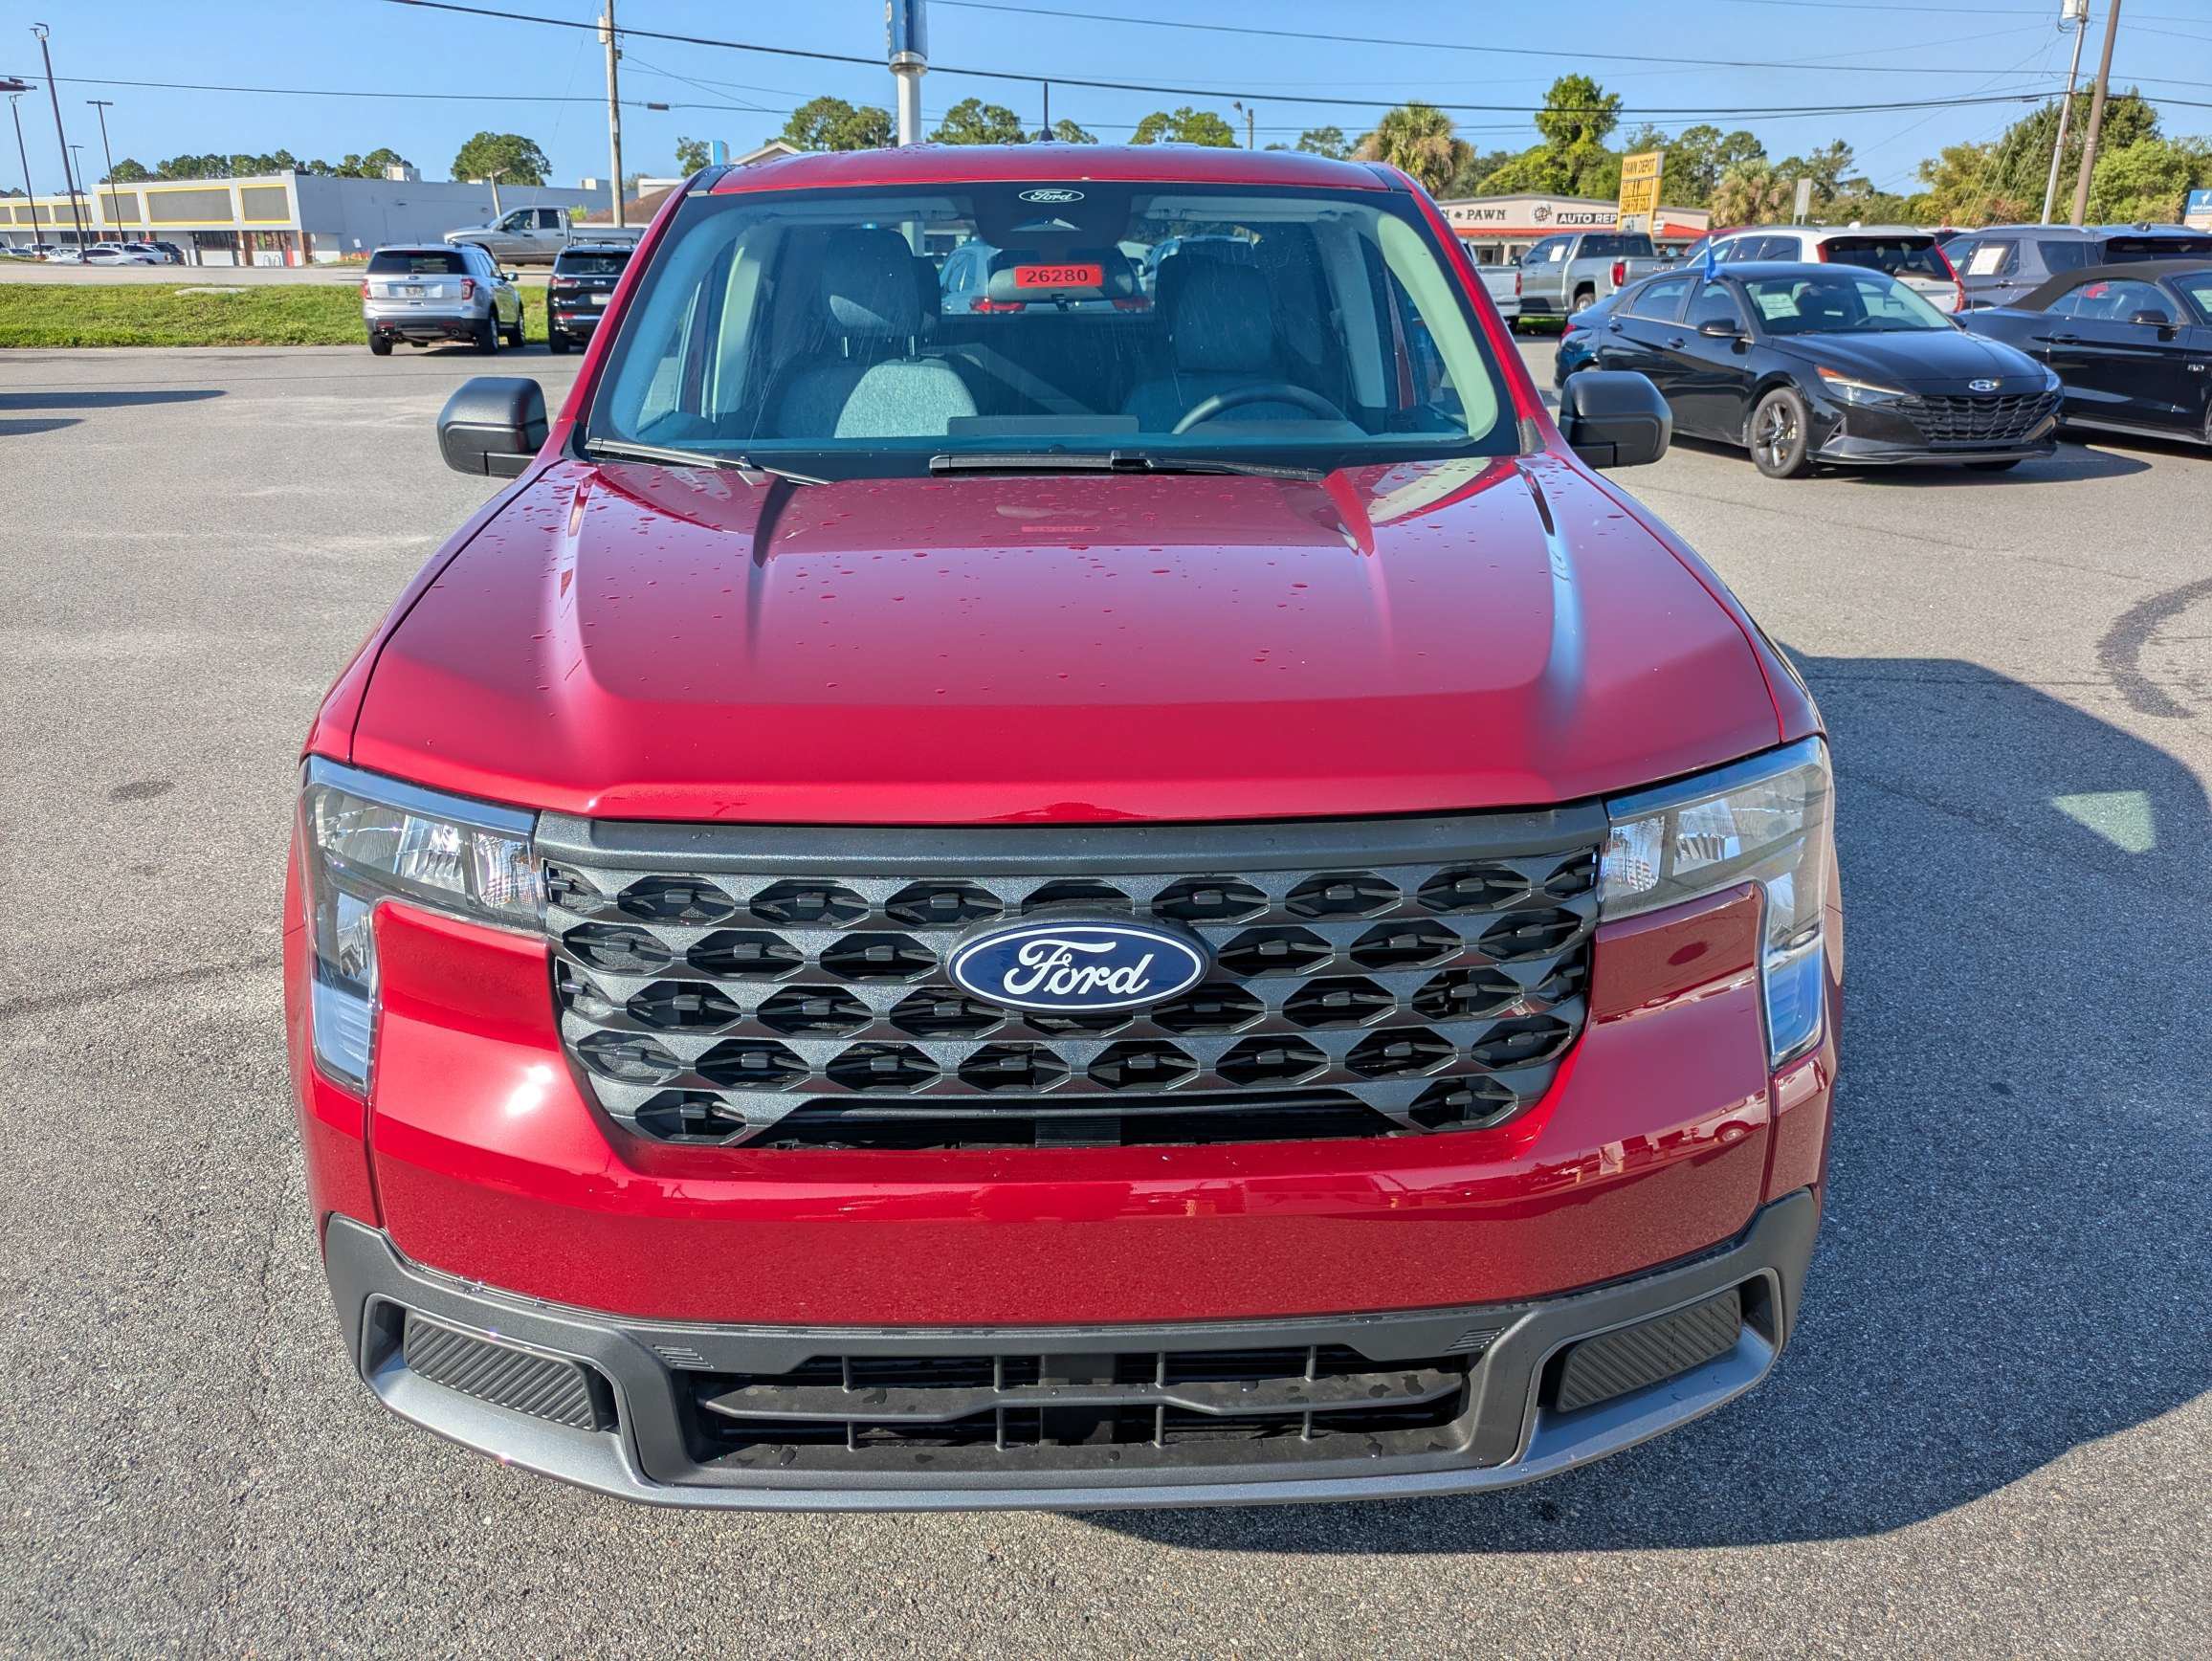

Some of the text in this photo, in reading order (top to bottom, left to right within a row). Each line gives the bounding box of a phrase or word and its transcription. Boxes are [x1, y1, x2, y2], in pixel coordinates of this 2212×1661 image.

[1030, 190, 1073, 201] Ford
[1467, 209, 1507, 220] PAWN
[1559, 213, 1592, 224] AUTO
[1594, 213, 1617, 224] REP
[1026, 269, 1088, 283] 26280
[1004, 939, 1154, 995] Ford
